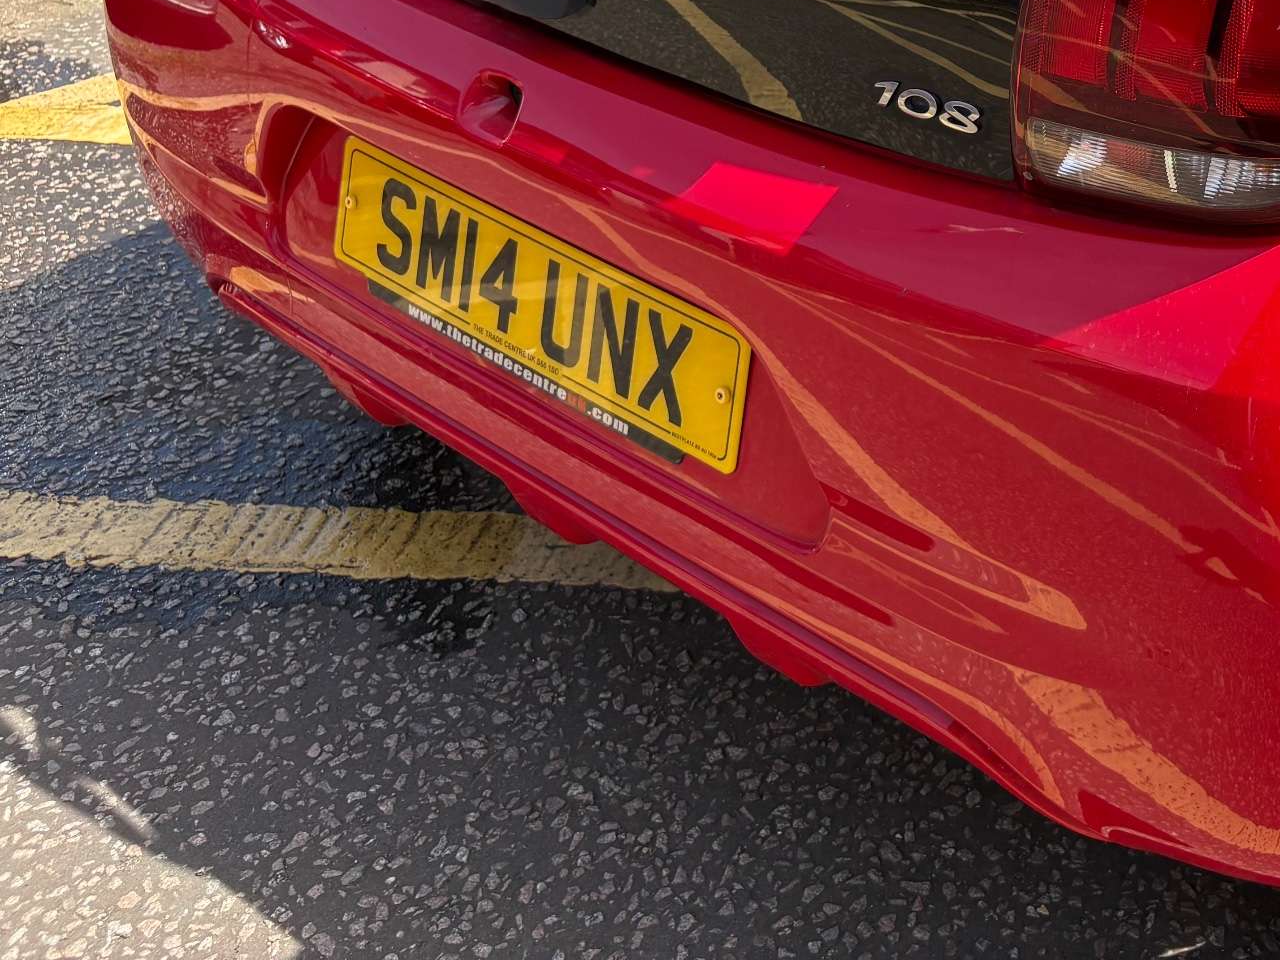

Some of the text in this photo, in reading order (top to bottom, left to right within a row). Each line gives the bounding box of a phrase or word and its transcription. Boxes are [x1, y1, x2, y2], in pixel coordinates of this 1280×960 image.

[874, 80, 981, 135] 108
[375, 176, 694, 428] SM14 UNX
[473, 323, 484, 335] THE
[485, 329, 502, 346] TRADE
[504, 340, 527, 358] CENTRE
